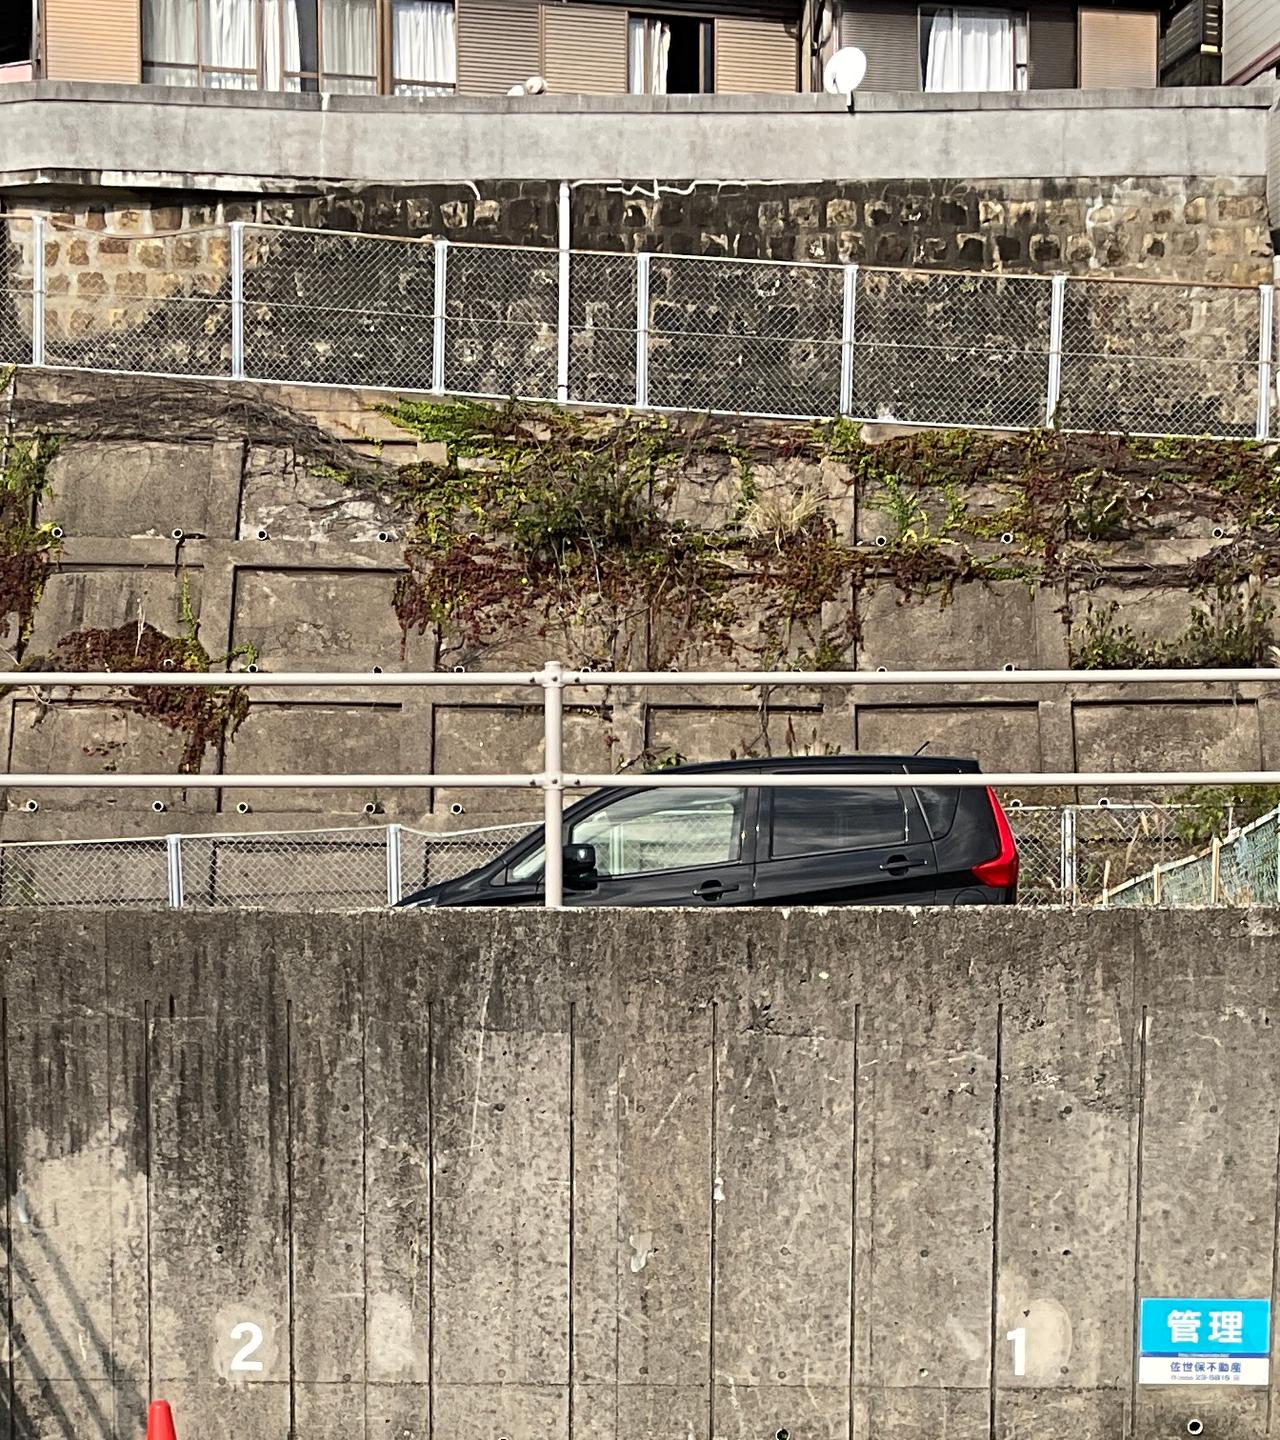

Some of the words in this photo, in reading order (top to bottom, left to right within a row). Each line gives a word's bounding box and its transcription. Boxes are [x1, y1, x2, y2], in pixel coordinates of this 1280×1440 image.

[231, 1322, 264, 1371] 2
[1167, 1310, 1243, 1344] 管理
[1007, 1328, 1026, 1375] 1
[1170, 1361, 1241, 1373] 佐世保不動産
